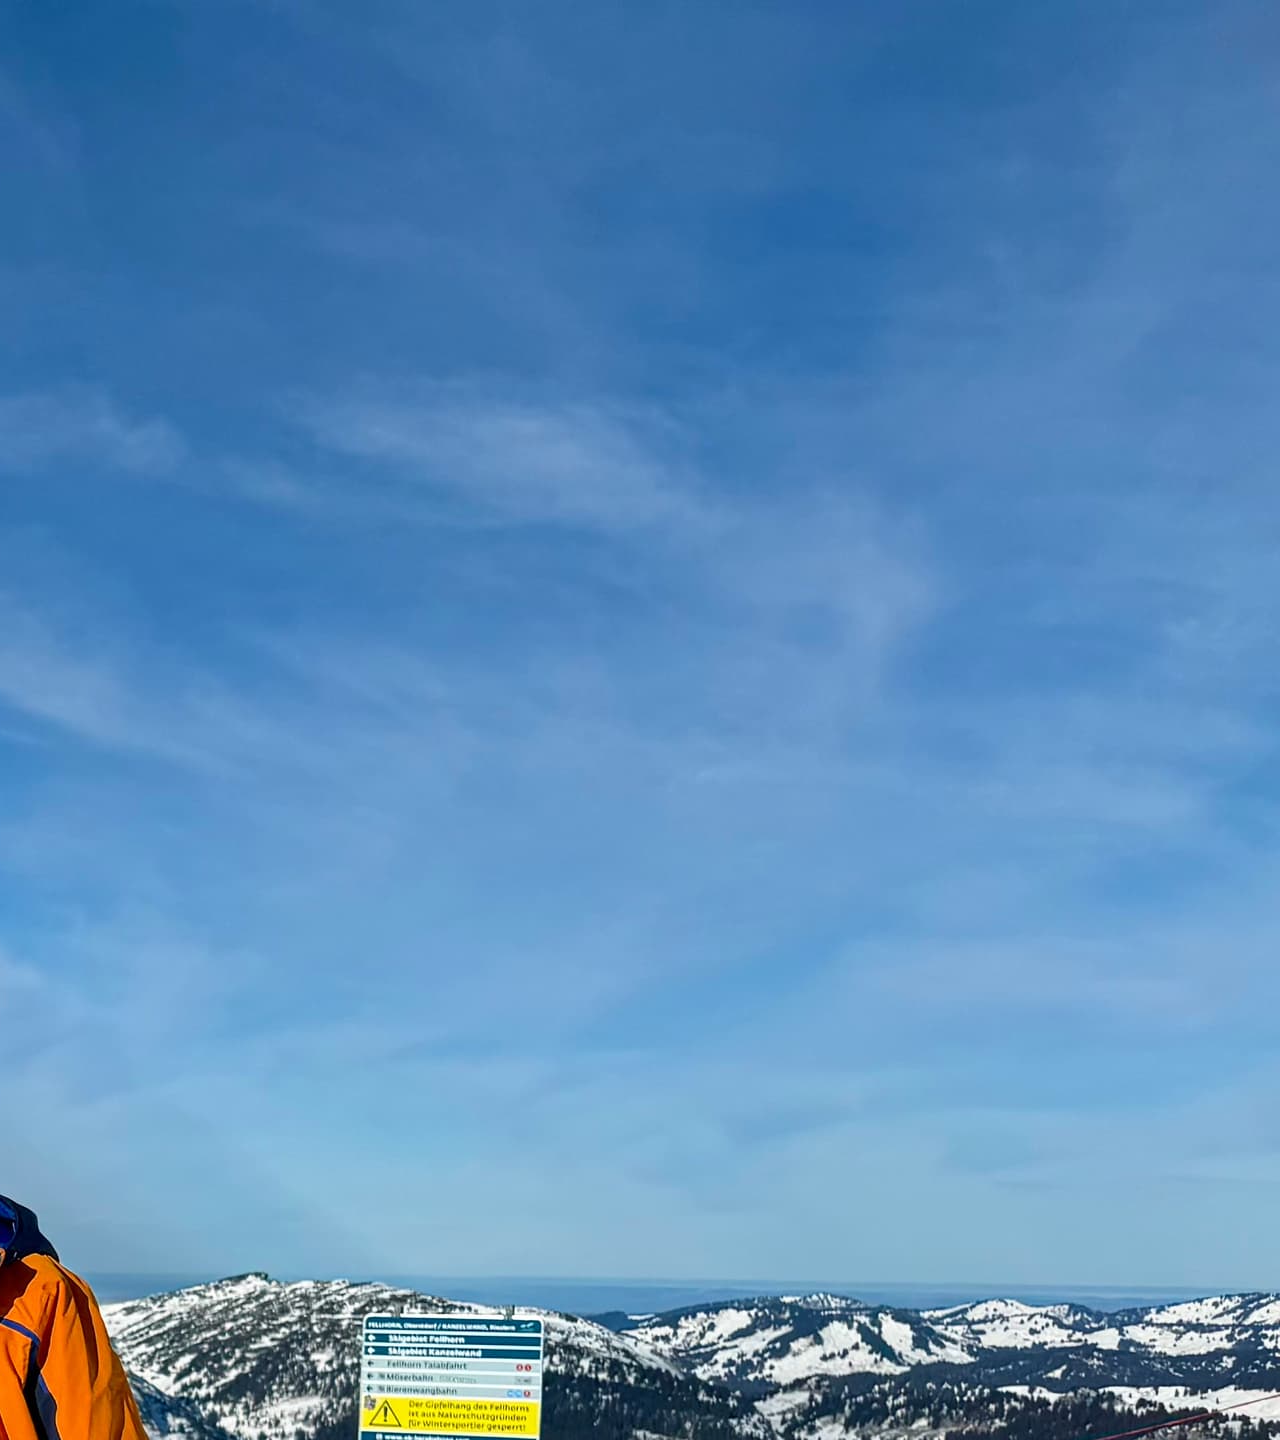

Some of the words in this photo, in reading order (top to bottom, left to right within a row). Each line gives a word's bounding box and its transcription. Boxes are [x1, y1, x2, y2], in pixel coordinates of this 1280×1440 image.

[388, 1333, 428, 1344] Skigebiet
[429, 1335, 465, 1344] Fellhorn
[387, 1346, 428, 1357] Skigebiet
[429, 1348, 482, 1358] Kanzelwand
[387, 1360, 422, 1368] Fellhorn
[424, 1361, 467, 1370] Talabfahrt
[408, 1400, 424, 1408] Der
[425, 1401, 471, 1411] Gipfelhang
[490, 1404, 529, 1412] Fellhorns
[437, 1412, 527, 1421] Naturschutzgründen
[408, 1420, 421, 1428] für
[422, 1420, 484, 1429] Wintersportler
[486, 1423, 526, 1431] gesperrt!
